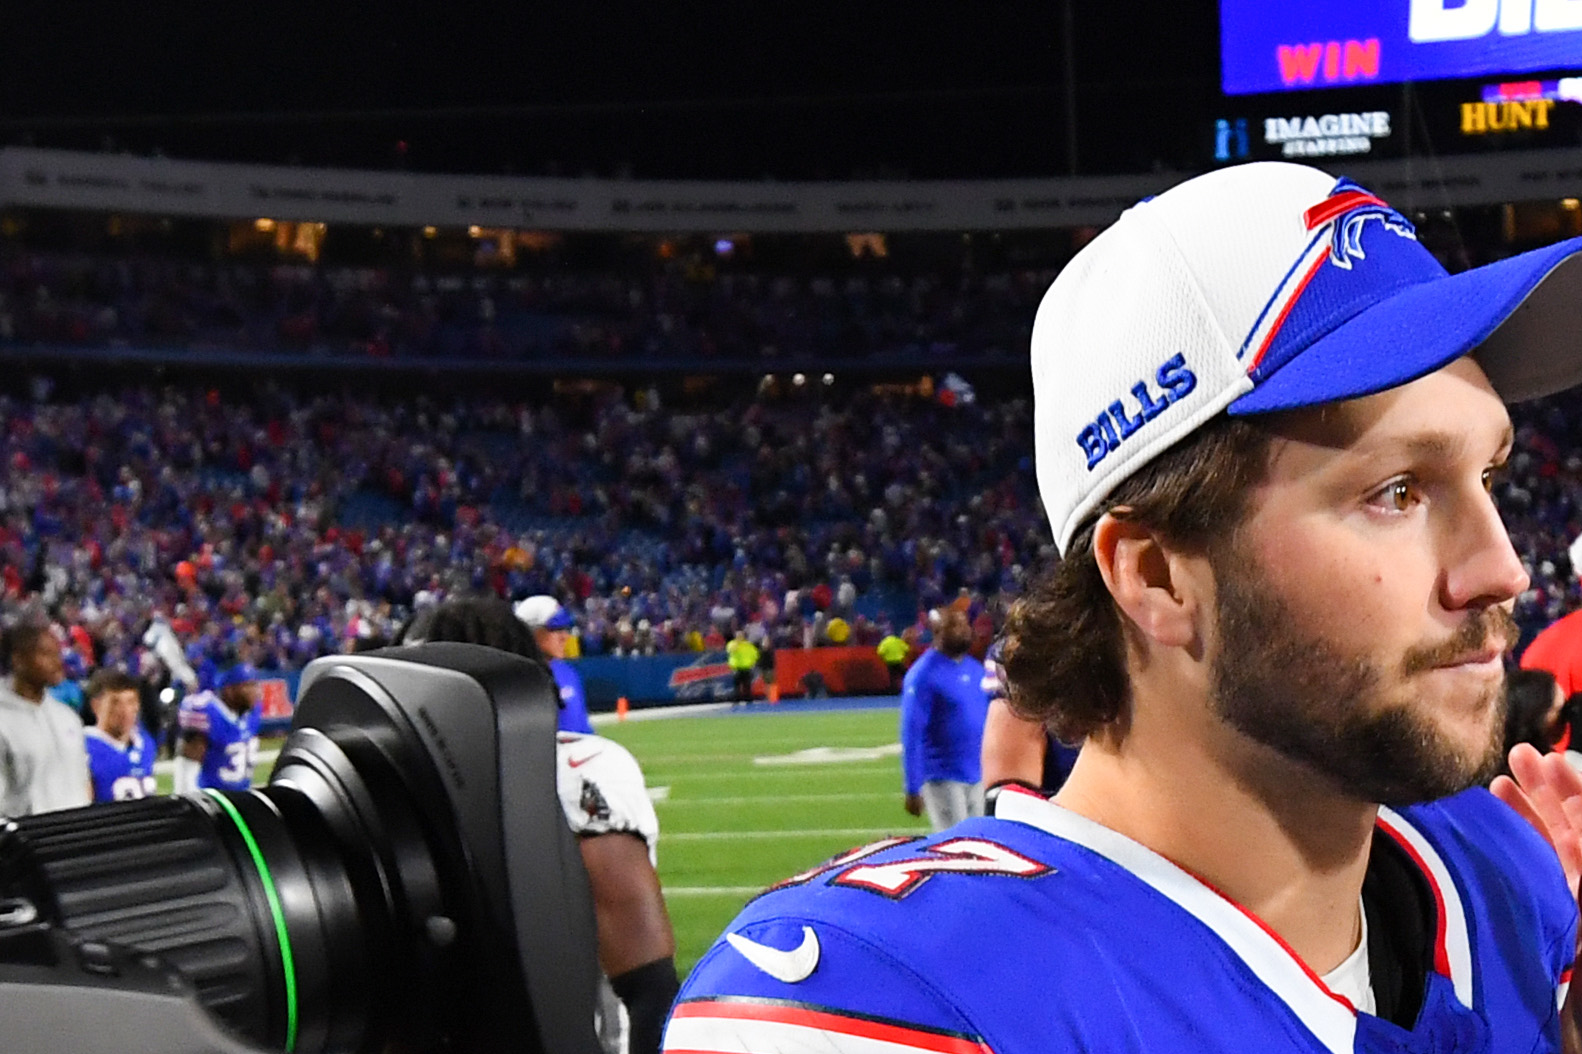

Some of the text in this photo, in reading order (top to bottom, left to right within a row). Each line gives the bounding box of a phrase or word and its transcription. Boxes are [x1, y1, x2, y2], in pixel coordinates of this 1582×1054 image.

[1277, 38, 1381, 84] WIN
[1264, 111, 1392, 144] IMAGINE
[1459, 98, 1555, 134] HUNT
[1076, 351, 1198, 472] BILLS
